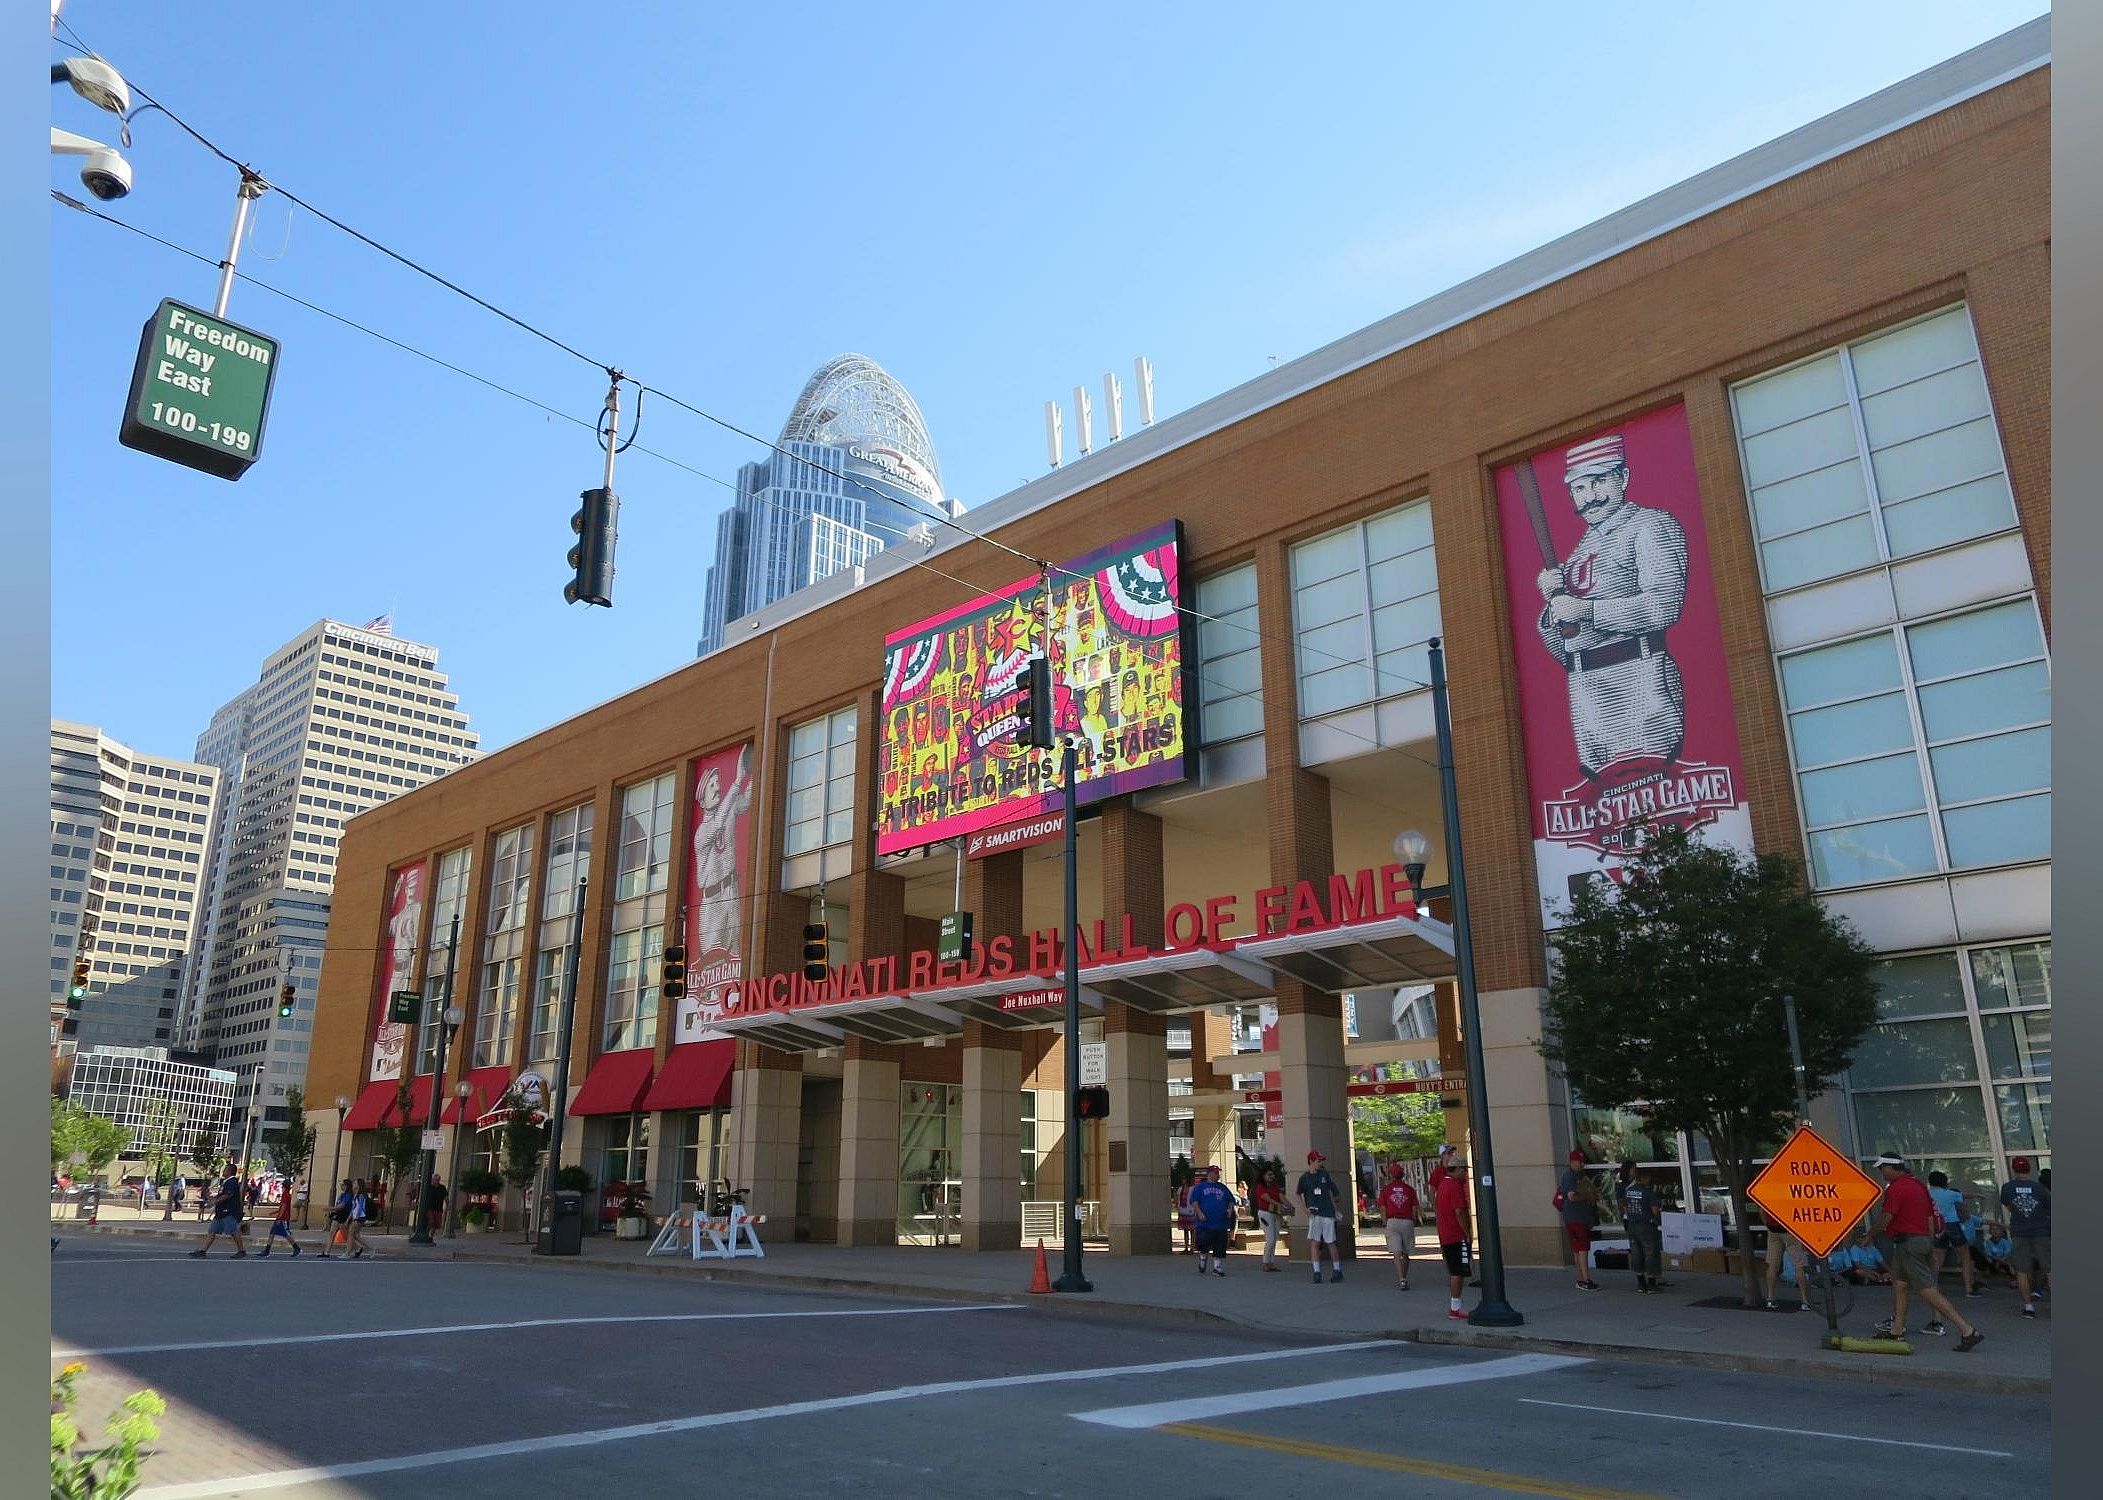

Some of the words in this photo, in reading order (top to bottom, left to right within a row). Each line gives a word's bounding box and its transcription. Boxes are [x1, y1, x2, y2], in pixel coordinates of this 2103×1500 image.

[169, 310, 271, 365] Freedom
[165, 334, 216, 373] Way
[157, 359, 212, 397] East
[151, 402, 251, 451] 100-199
[848, 445, 888, 469] GREAT
[405, 644, 437, 662] Bell
[977, 715, 1020, 748] QUEEN
[899, 780, 968, 823] TRIBUTE
[975, 774, 997, 800] TO
[1004, 757, 1053, 796] REDS
[1603, 772, 1664, 798] CINCINNATI
[1659, 774, 1728, 808] GAME
[986, 818, 1062, 848] SMARTVISION
[941, 926, 956, 936] Street
[942, 917, 954, 926] Main
[720, 954, 898, 1017] CINCINNATI
[909, 935, 1015, 988] REDS
[1029, 913, 1149, 972] HALL
[1165, 896, 1237, 947] OF
[1254, 863, 1417, 936] FAME
[721, 962, 741, 980] GAM
[1003, 997, 1016, 1008] Joe
[1018, 994, 1046, 1006] Nuxhall
[1047, 991, 1063, 1003] Way
[1790, 1160, 1831, 1176] ROAD
[1789, 1184, 1839, 1199] WORK
[1792, 1207, 1842, 1223] AHEAD
